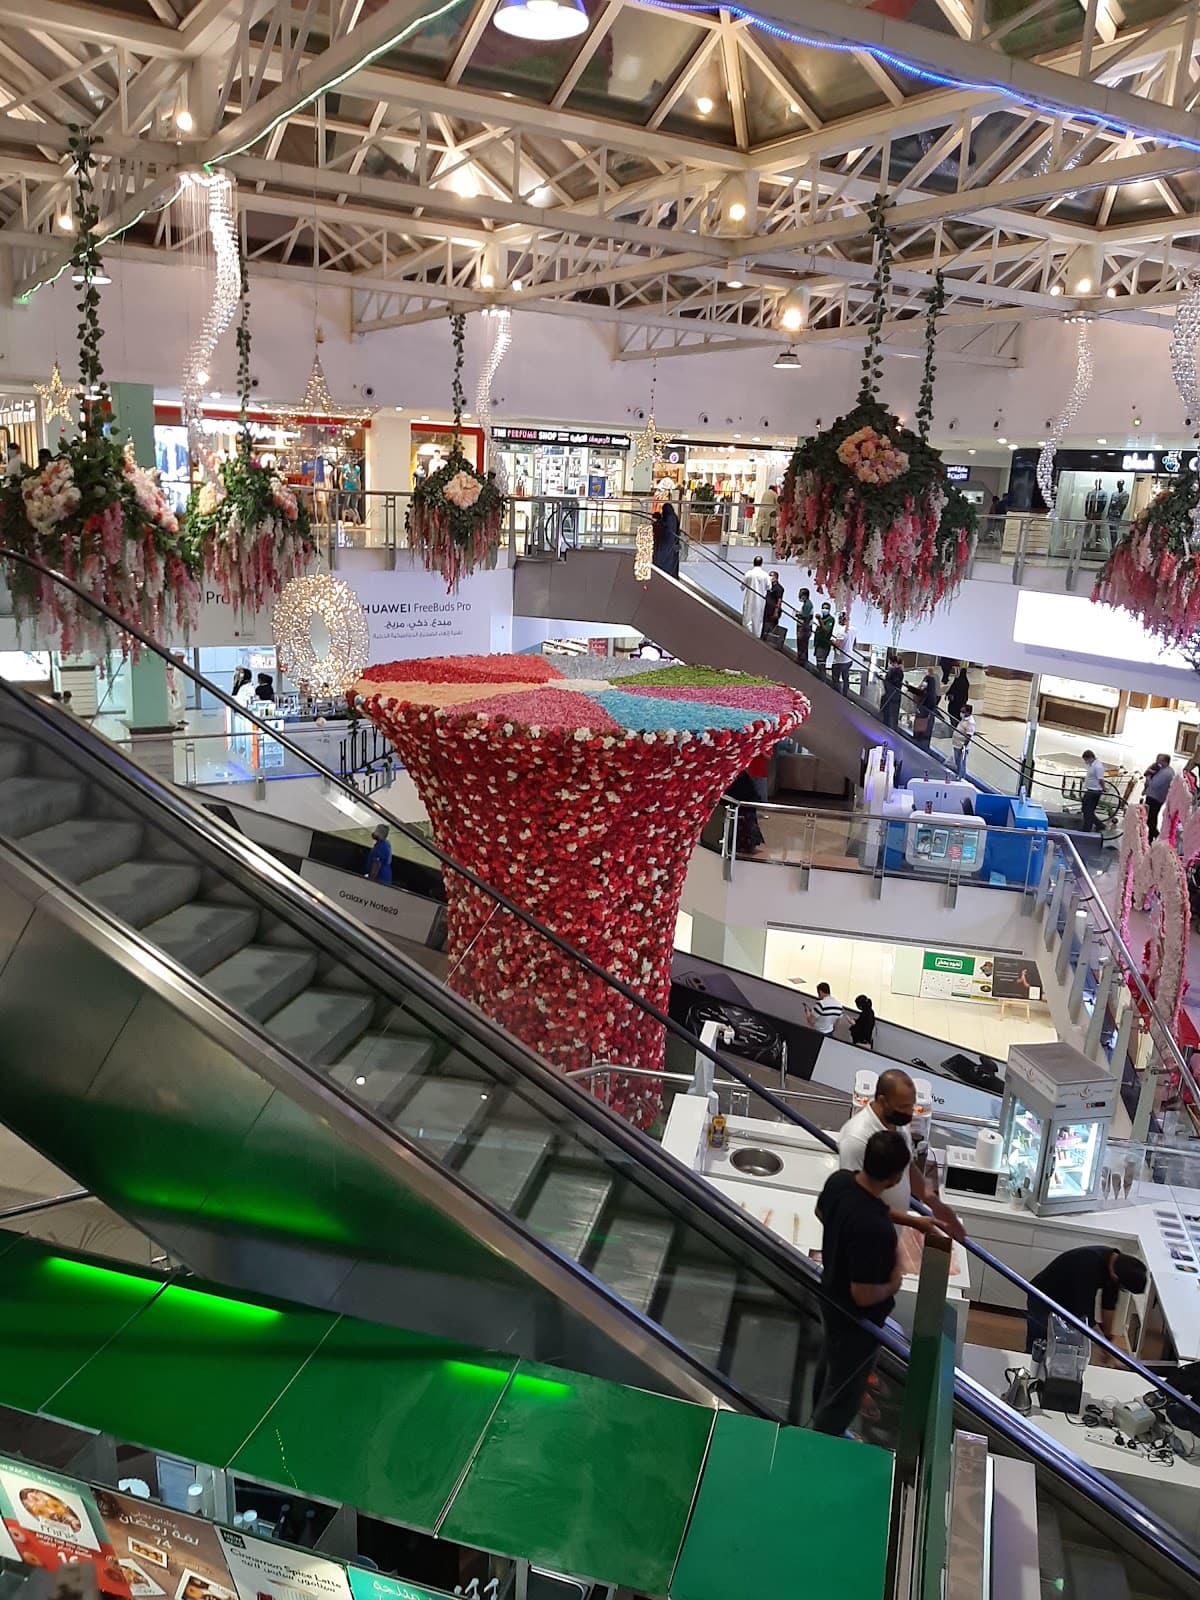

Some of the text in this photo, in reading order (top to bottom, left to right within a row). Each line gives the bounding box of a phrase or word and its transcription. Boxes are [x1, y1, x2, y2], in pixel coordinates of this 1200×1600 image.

[507, 429, 537, 439] PERFUME
[538, 431, 557, 441] SHOP
[361, 601, 472, 614] HUAWEI FreeBuds Pro
[339, 890, 399, 916] Galaxy Note20
[119, 1513, 168, 1537] رمضان
[230, 1547, 283, 1571] Cinnamon
[284, 1564, 312, 1579] Spice
[314, 1573, 342, 1589] Latte
